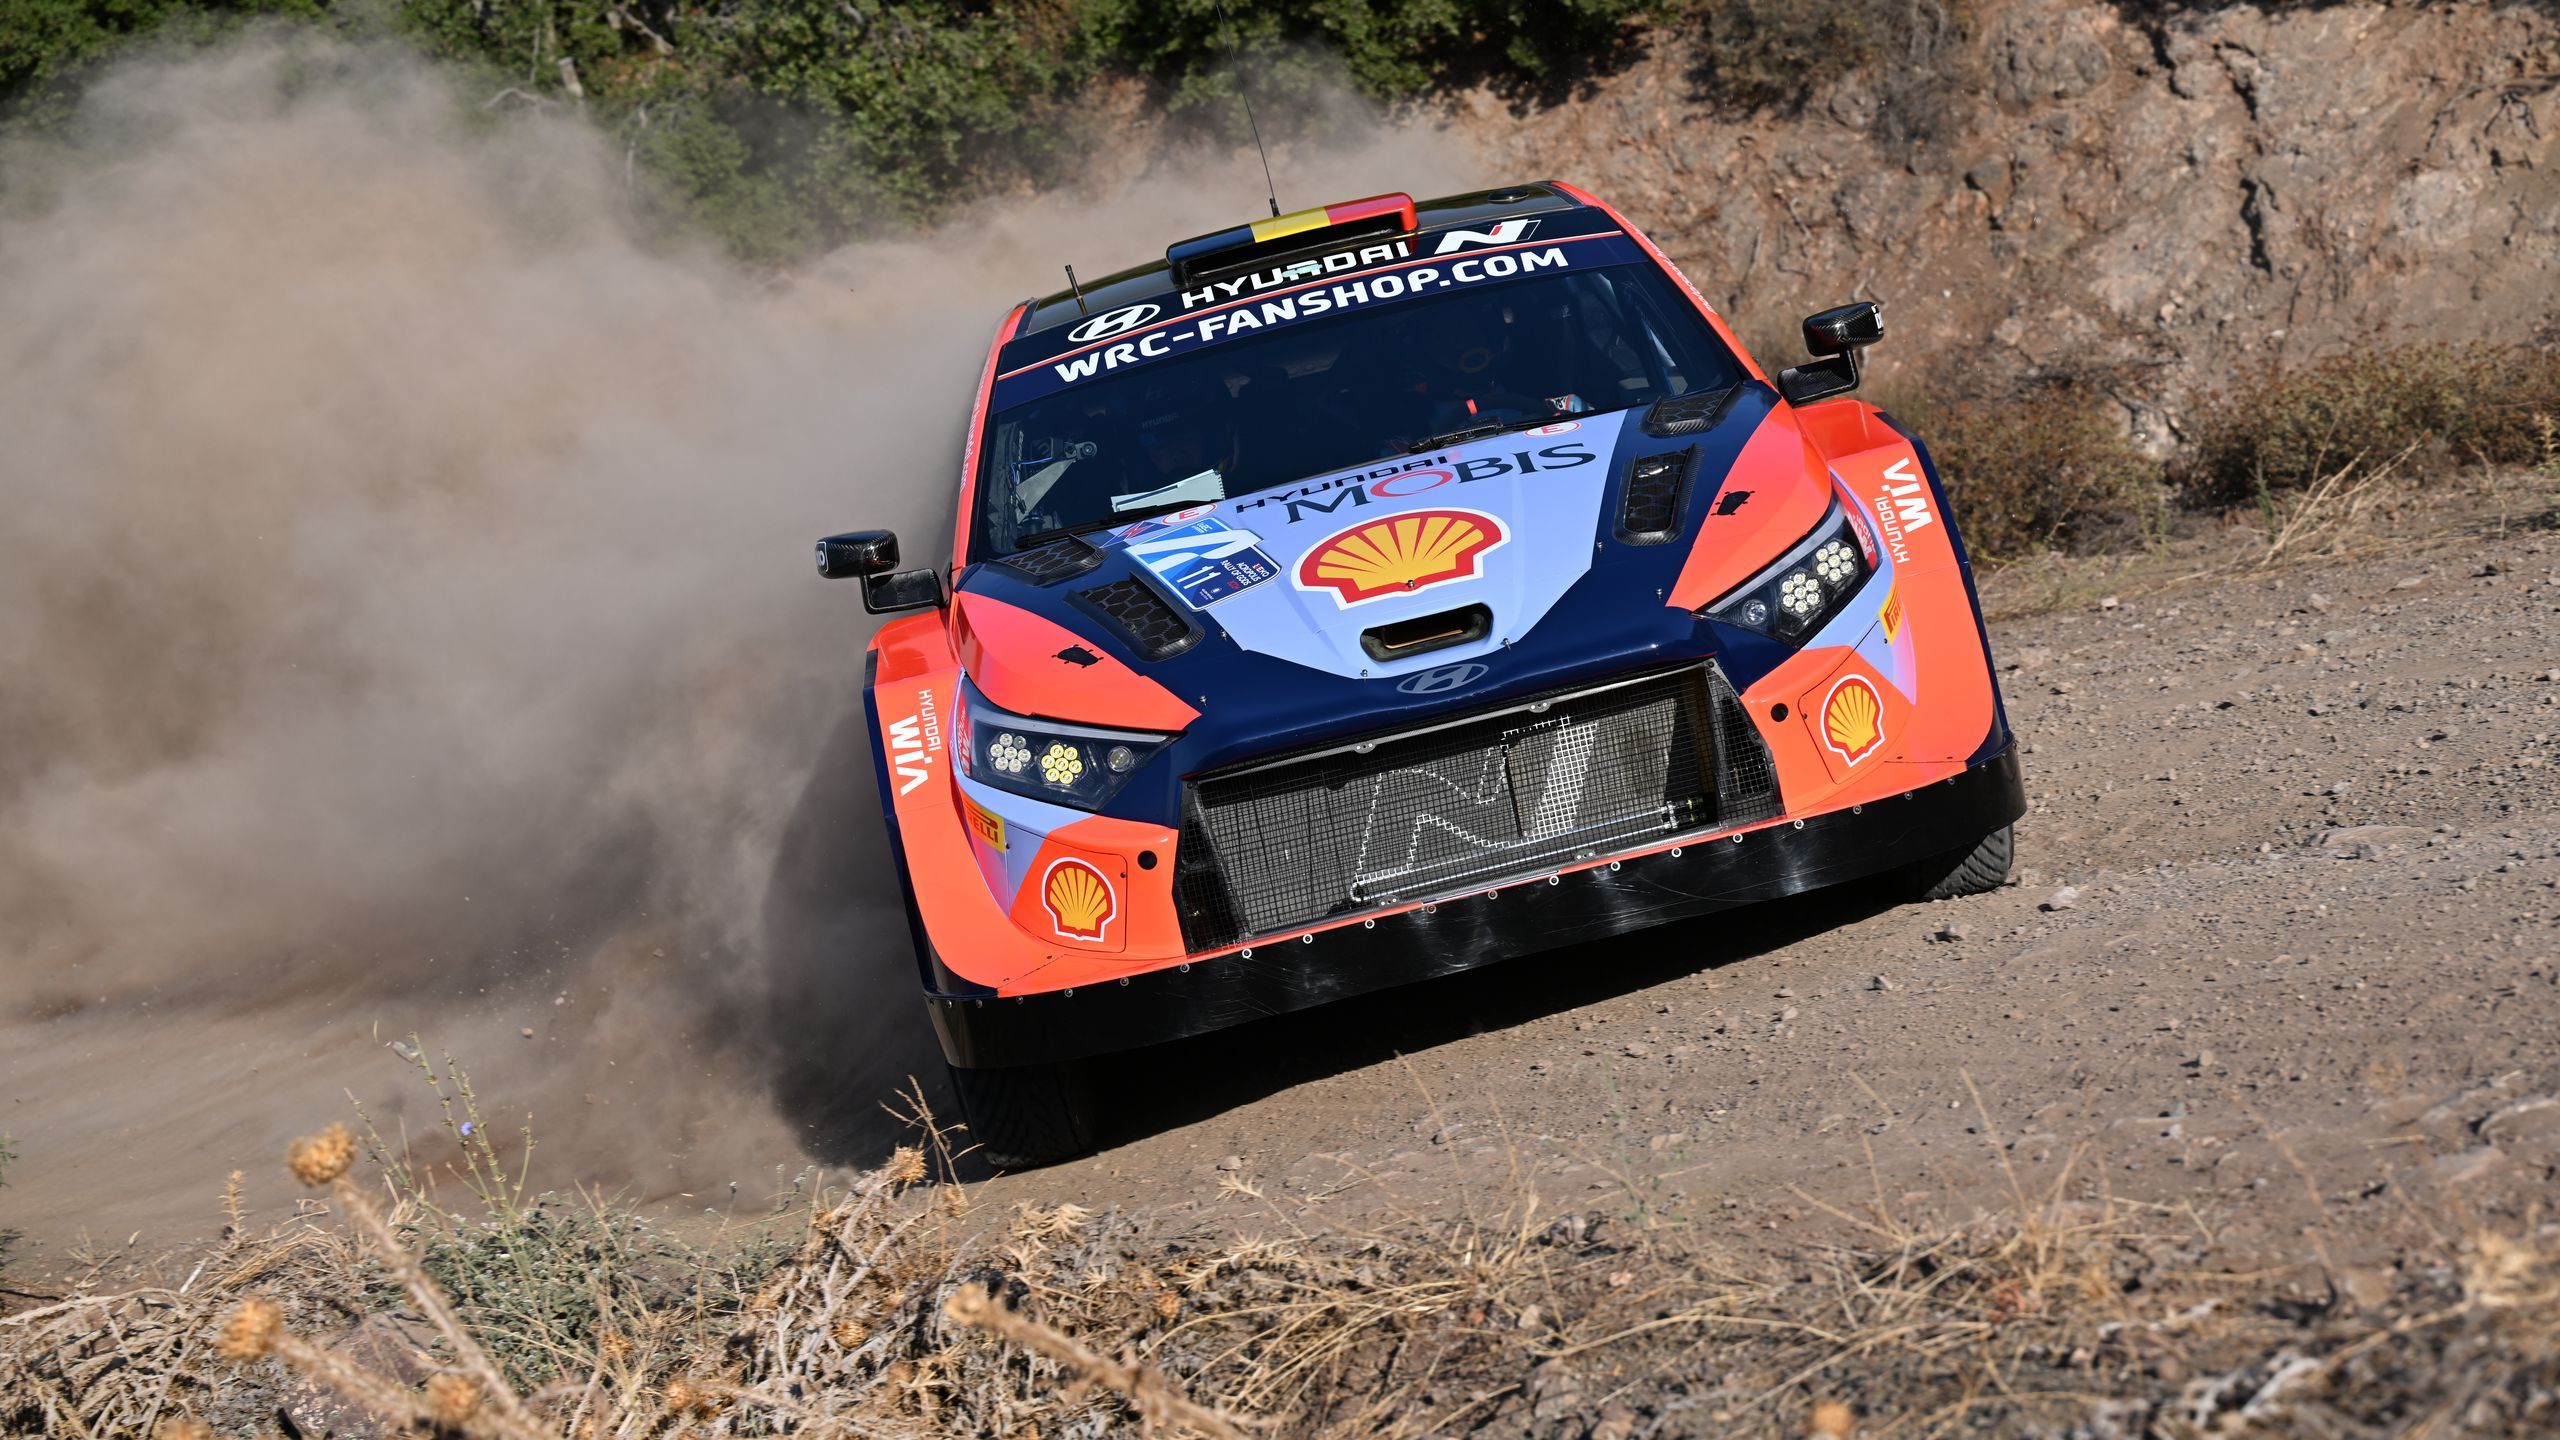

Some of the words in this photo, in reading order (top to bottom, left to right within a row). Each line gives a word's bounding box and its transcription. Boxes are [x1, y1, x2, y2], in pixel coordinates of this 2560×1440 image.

[1181, 241, 1412, 309] HYUNDAI
[1055, 247, 1569, 383] WRC-FANSHOP.COM
[1236, 455, 1448, 513] HYUNDAI
[1286, 443, 1597, 525] MOBIS
[1874, 495, 1911, 564] HYUNDAI
[1176, 565, 1222, 590] 11
[1220, 559, 1234, 573] RALLY
[1236, 574, 1252, 586] GODS
[1236, 561, 1261, 582] ACROPOLIS
[918, 688, 943, 752] HYUNDAI
